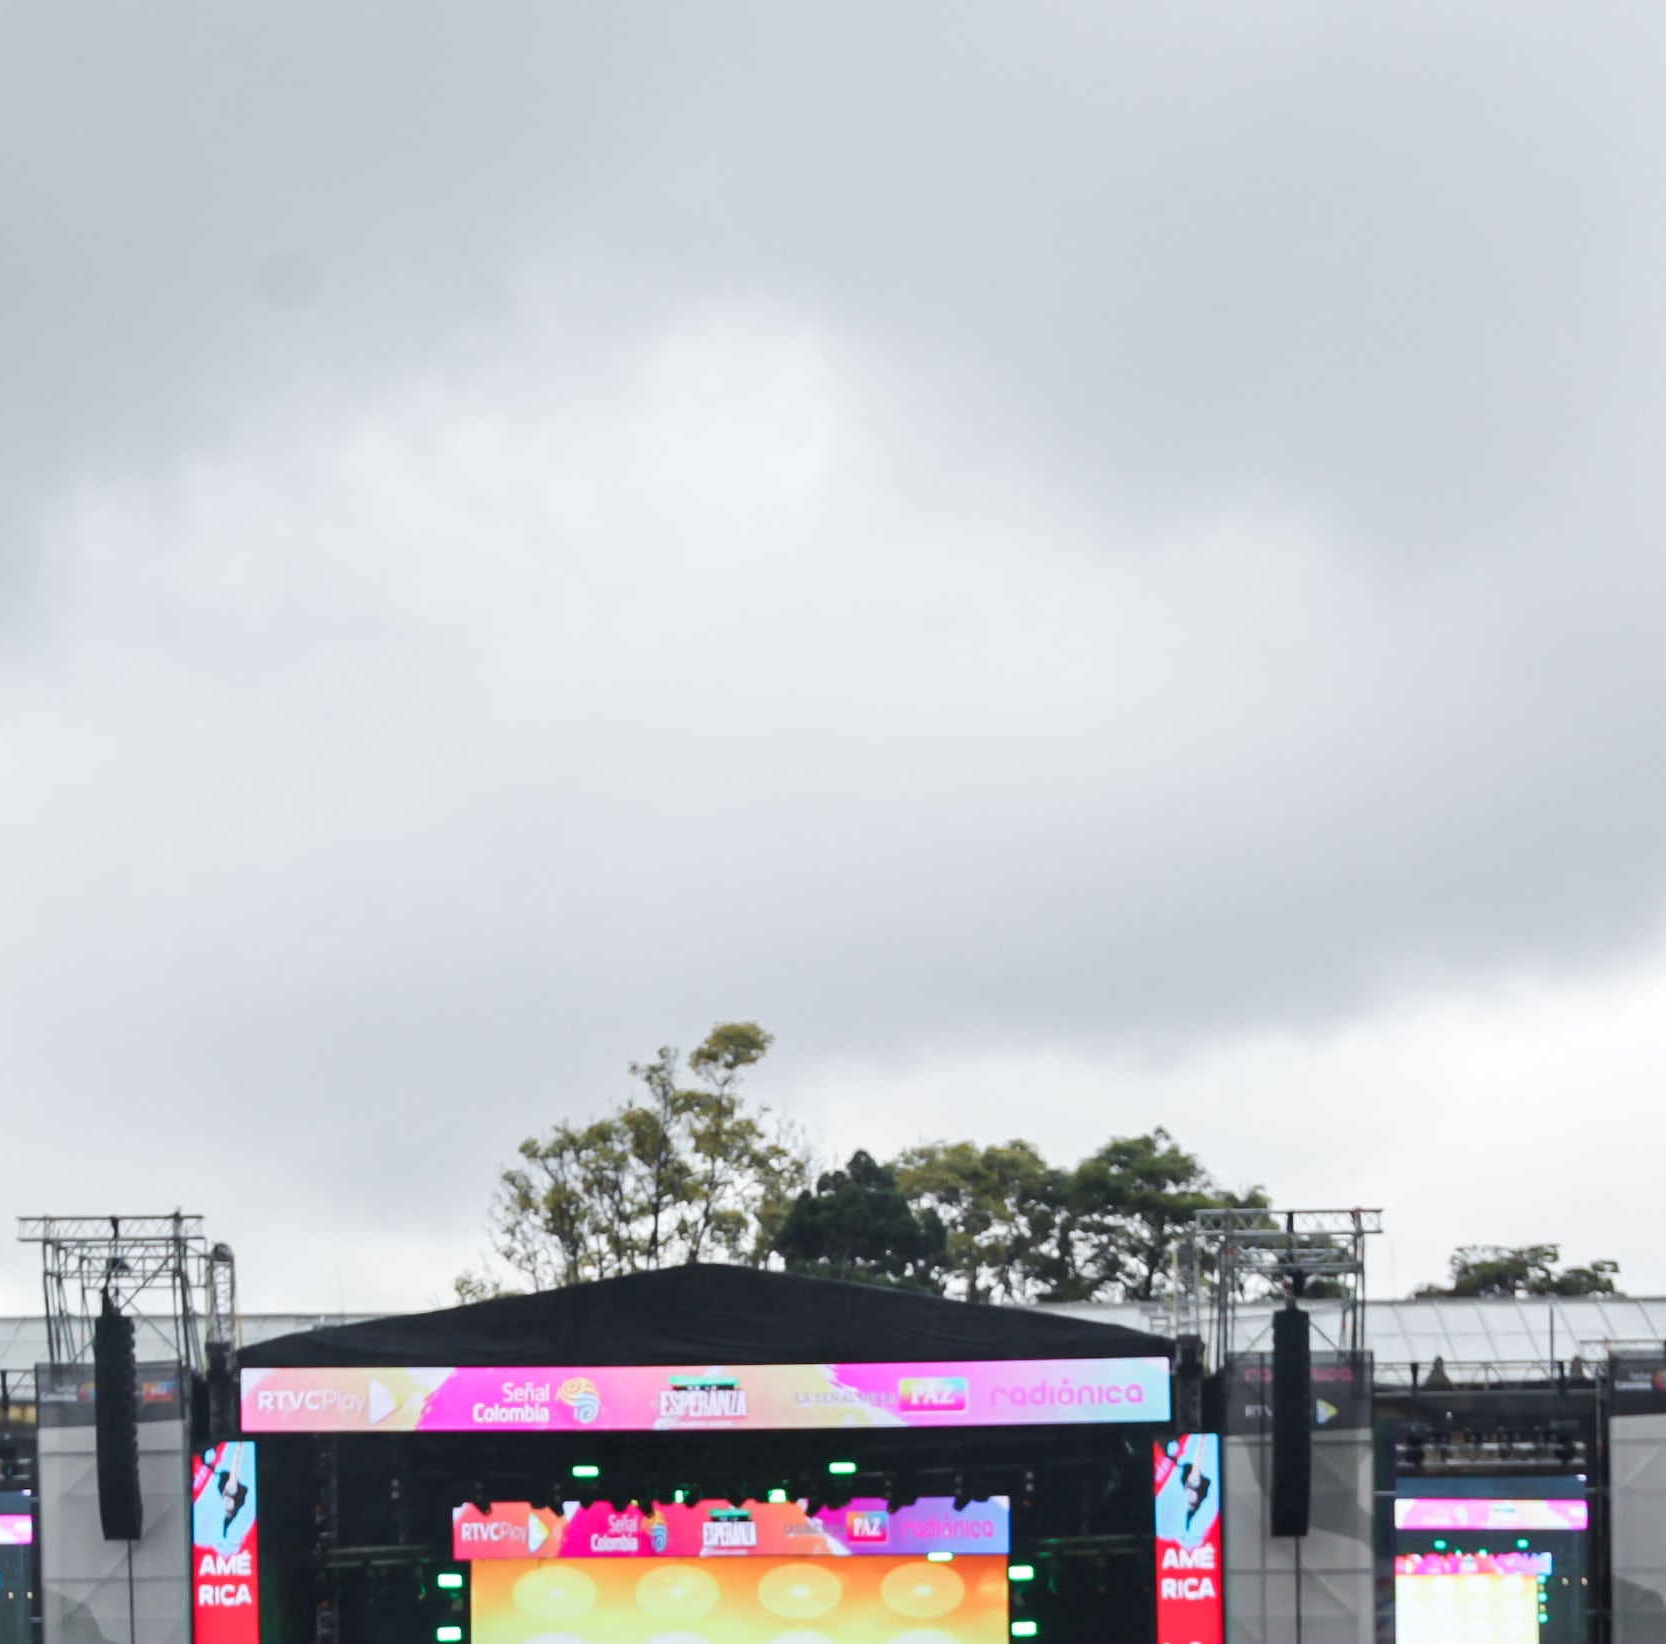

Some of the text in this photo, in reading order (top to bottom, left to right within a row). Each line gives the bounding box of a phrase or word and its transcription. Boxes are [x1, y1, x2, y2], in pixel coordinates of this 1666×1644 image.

[502, 1381, 550, 1403] Señal
[910, 1384, 956, 1405] PAZ
[990, 1378, 1144, 1407] radiónica
[257, 1388, 367, 1421] RTVCPlay
[472, 1402, 550, 1425] Colombia
[608, 1514, 638, 1534] Señal
[852, 1516, 882, 1537] PAZ
[590, 1533, 639, 1553] Colombia
[199, 1550, 252, 1577] AMÉ
[1161, 1545, 1215, 1570] AMÉ
[199, 1583, 252, 1607] RICA
[1161, 1577, 1216, 1600] RICA
